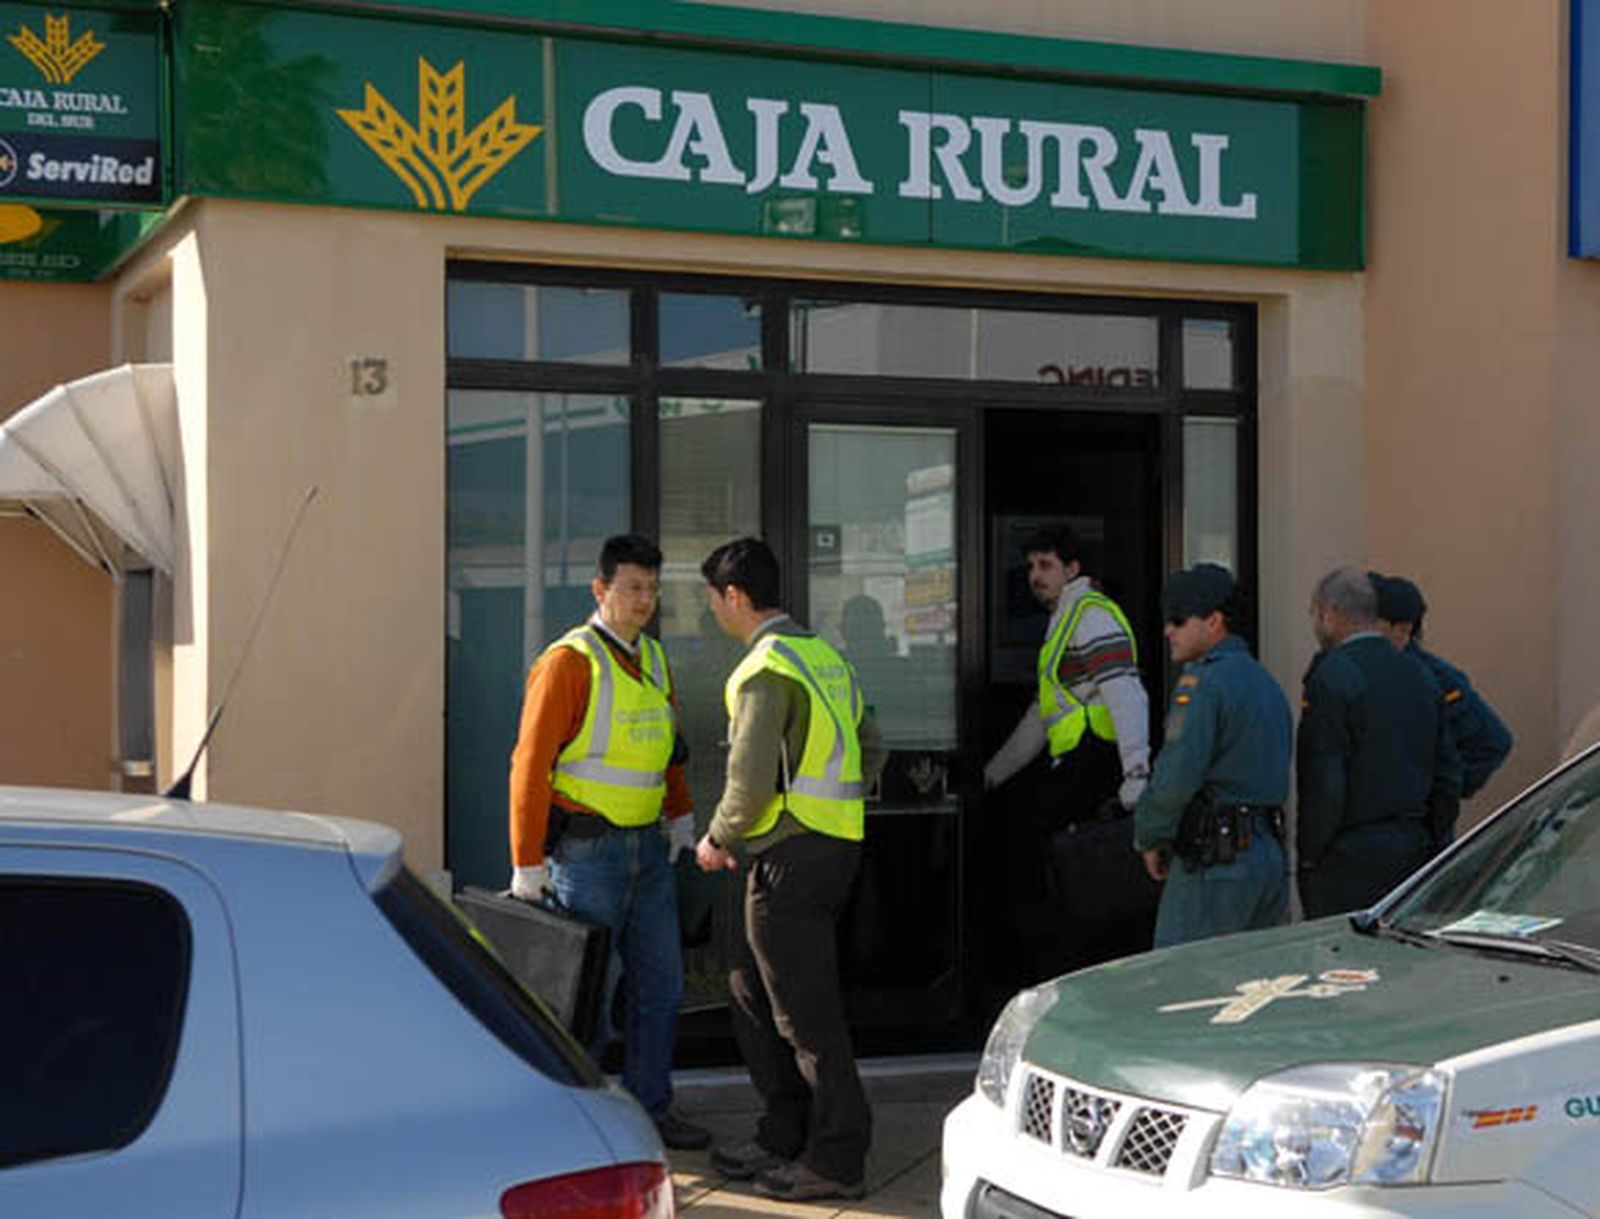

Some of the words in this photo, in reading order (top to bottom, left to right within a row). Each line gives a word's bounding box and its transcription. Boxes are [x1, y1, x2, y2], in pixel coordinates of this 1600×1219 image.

[53, 91, 128, 114] RURAL
[26, 152, 154, 186] ServiRed
[583, 85, 874, 195] CAJA
[899, 109, 1257, 220] RURAL
[351, 360, 387, 395] 13
[1565, 1096, 1600, 1118] GU
